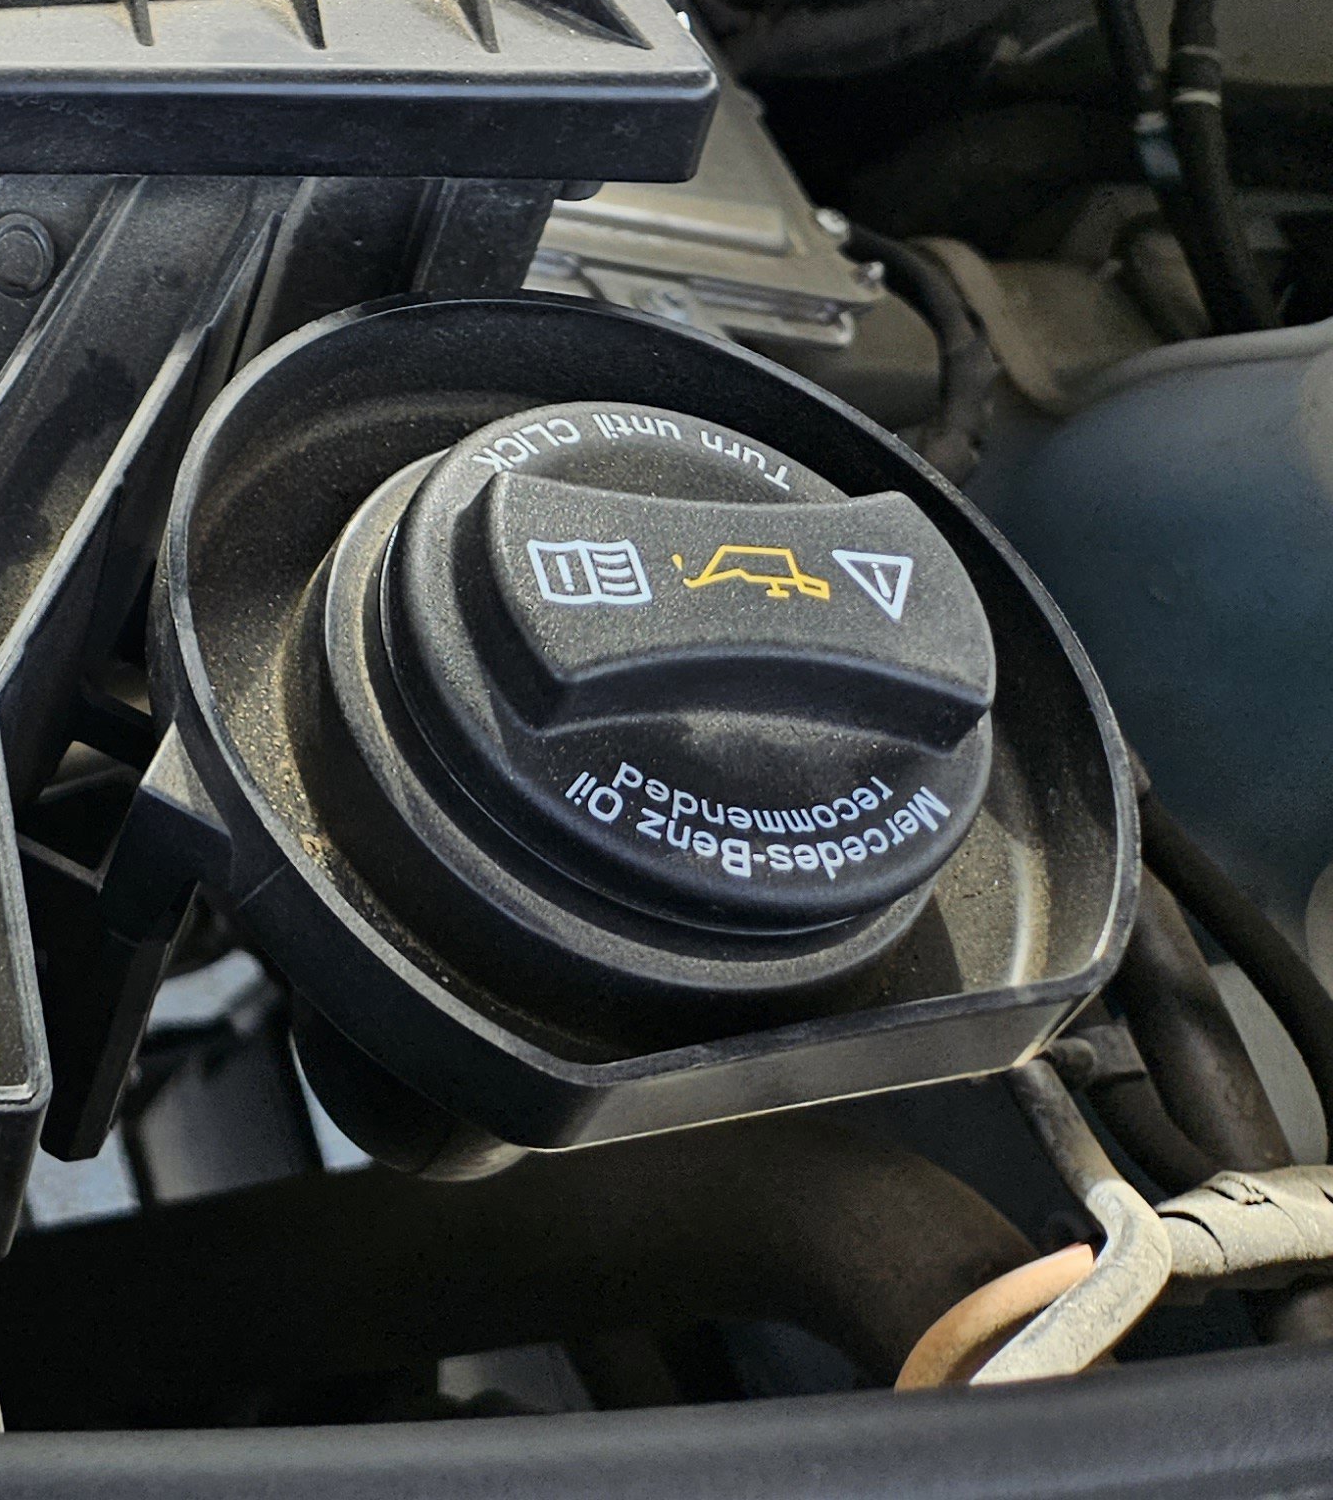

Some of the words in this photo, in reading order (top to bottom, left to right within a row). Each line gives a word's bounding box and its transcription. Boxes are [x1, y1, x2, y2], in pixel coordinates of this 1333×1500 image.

[471, 418, 581, 473] CLICK
[592, 413, 682, 440] until
[700, 430, 790, 491] Turn
[565, 771, 623, 823] Oil
[611, 762, 893, 834] recommended
[636, 786, 951, 880] Mercedes-Benz
